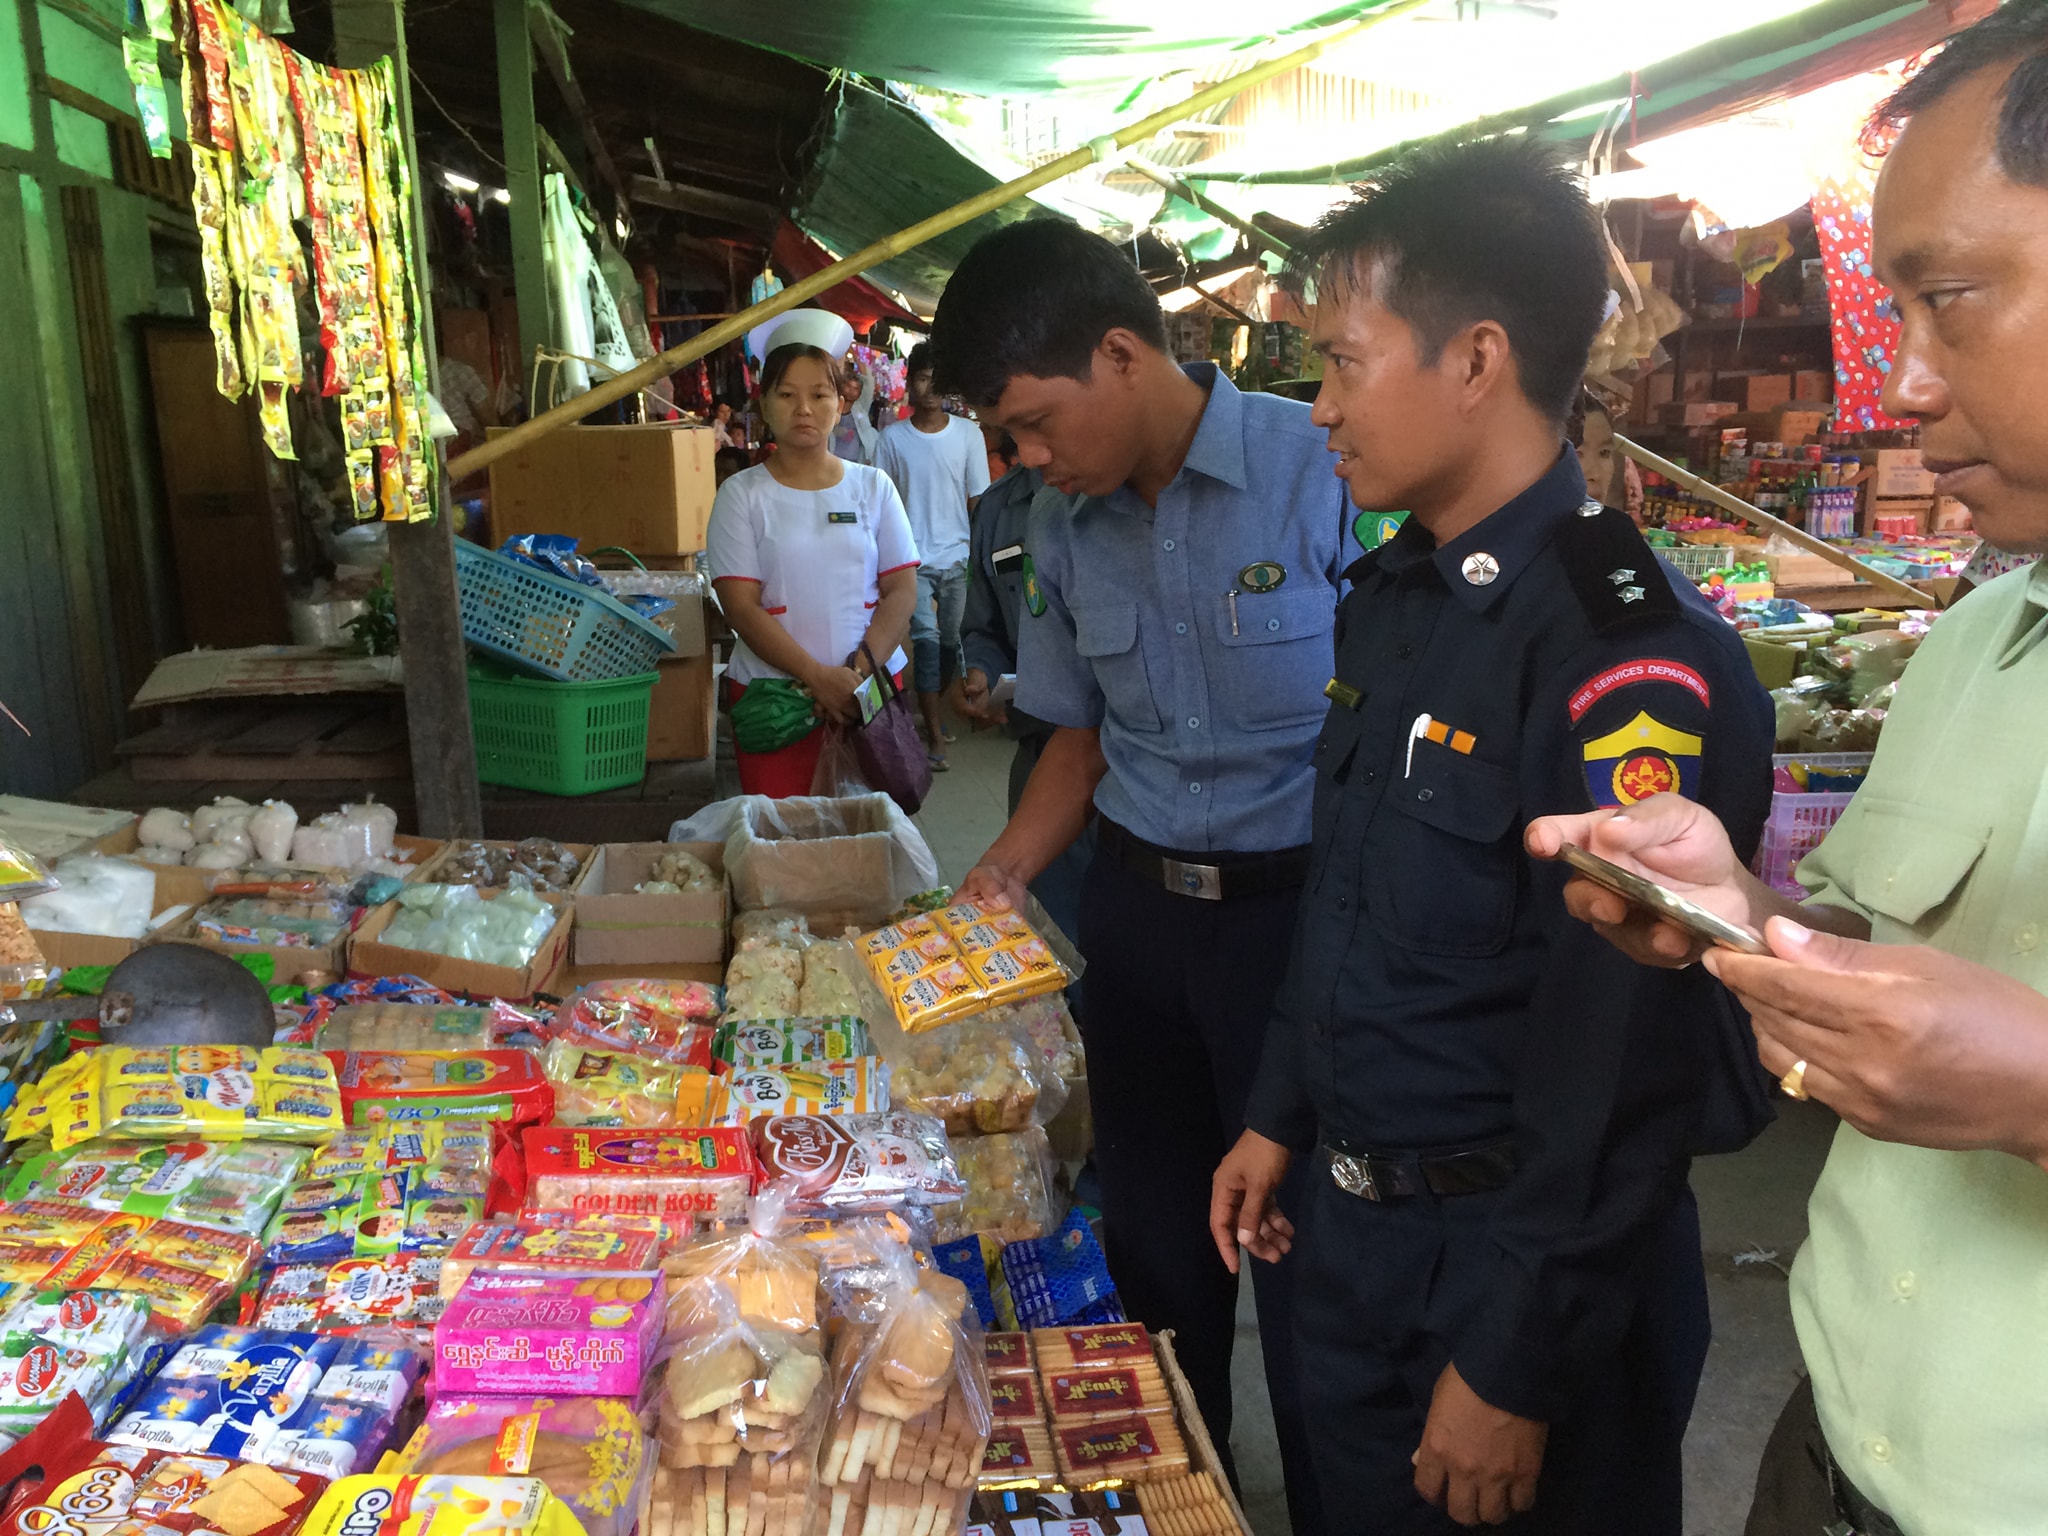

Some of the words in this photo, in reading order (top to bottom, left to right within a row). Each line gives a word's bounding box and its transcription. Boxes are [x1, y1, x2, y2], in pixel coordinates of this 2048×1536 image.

[1573, 690, 1595, 711] FIRE
[1594, 665, 1644, 692] SERVICES
[1648, 664, 1708, 698] DEPARTMENT
[388, 1105, 441, 1120] BO
[785, 1131, 824, 1167] Kiss
[573, 1193, 658, 1211] GOLDEN
[665, 1193, 718, 1212] ROSE
[350, 1271, 373, 1301] CORN
[221, 1356, 291, 1416] Vanilla
[342, 1373, 389, 1393] Vanilla
[126, 1420, 175, 1445] Vanilla
[285, 1439, 333, 1467] Vanilla
